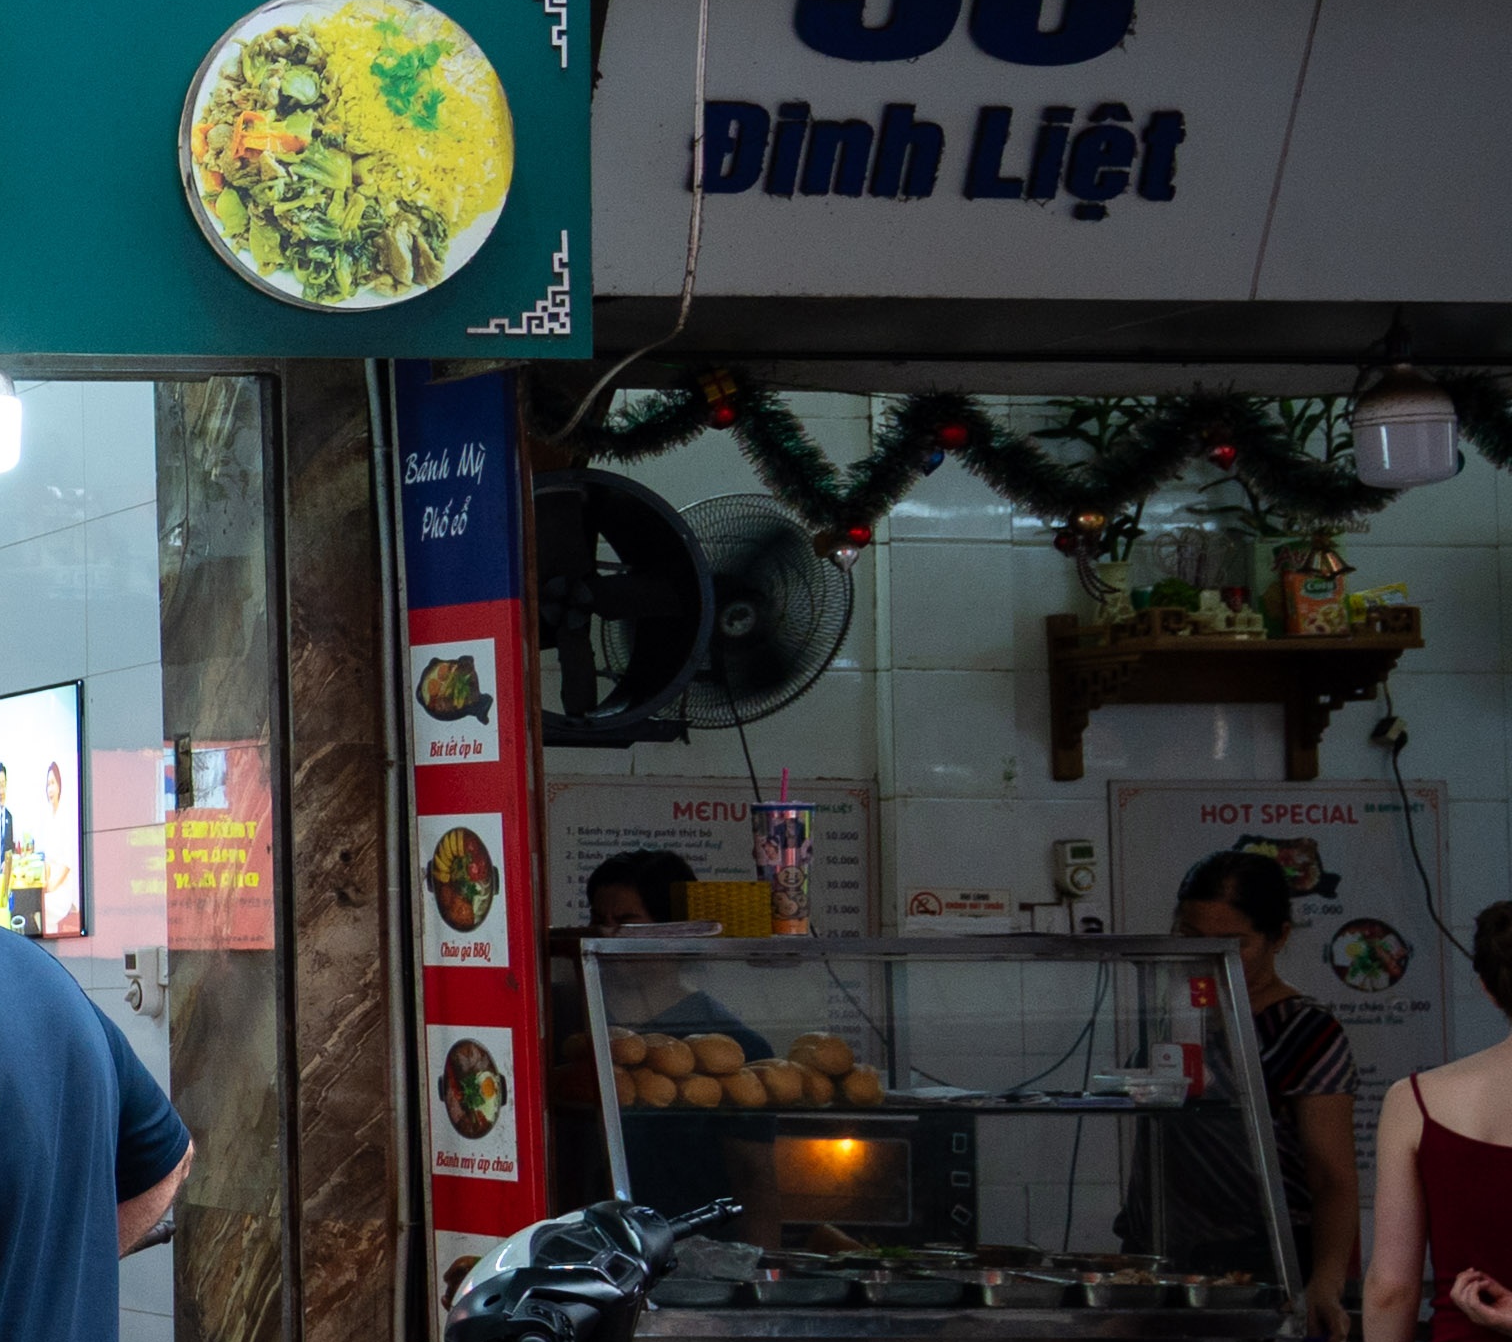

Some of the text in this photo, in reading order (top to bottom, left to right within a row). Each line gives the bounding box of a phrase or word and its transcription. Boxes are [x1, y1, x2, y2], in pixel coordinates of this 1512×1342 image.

[693, 99, 1188, 222] Đinh Liệt
[405, 447, 451, 485] Bánh
[672, 800, 748, 823] MENU
[1200, 802, 1359, 826] HOT SPECIAL
[473, 941, 491, 963] BBQ
